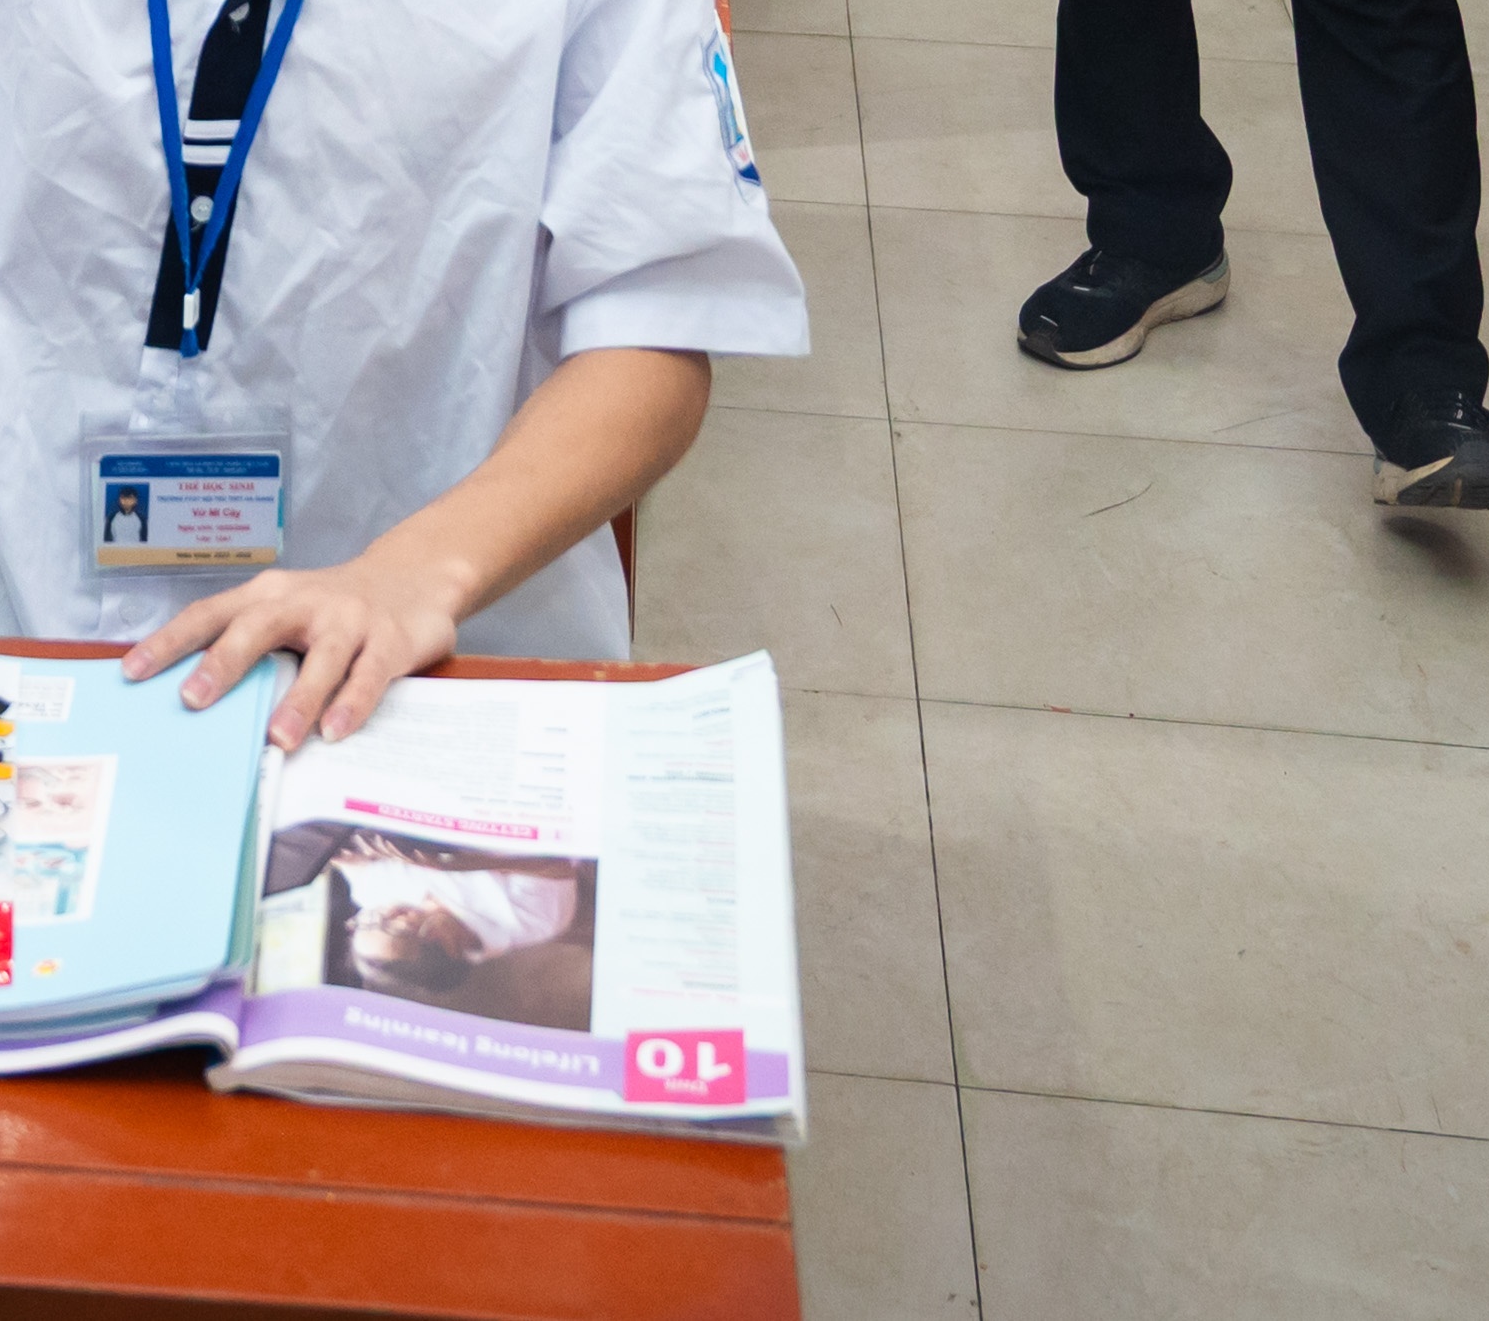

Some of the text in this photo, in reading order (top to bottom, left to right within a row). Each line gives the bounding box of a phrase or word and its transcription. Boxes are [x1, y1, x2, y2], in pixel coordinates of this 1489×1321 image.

[344, 1005, 601, 1077] Lifelong learning
[636, 1038, 733, 1082] 10
